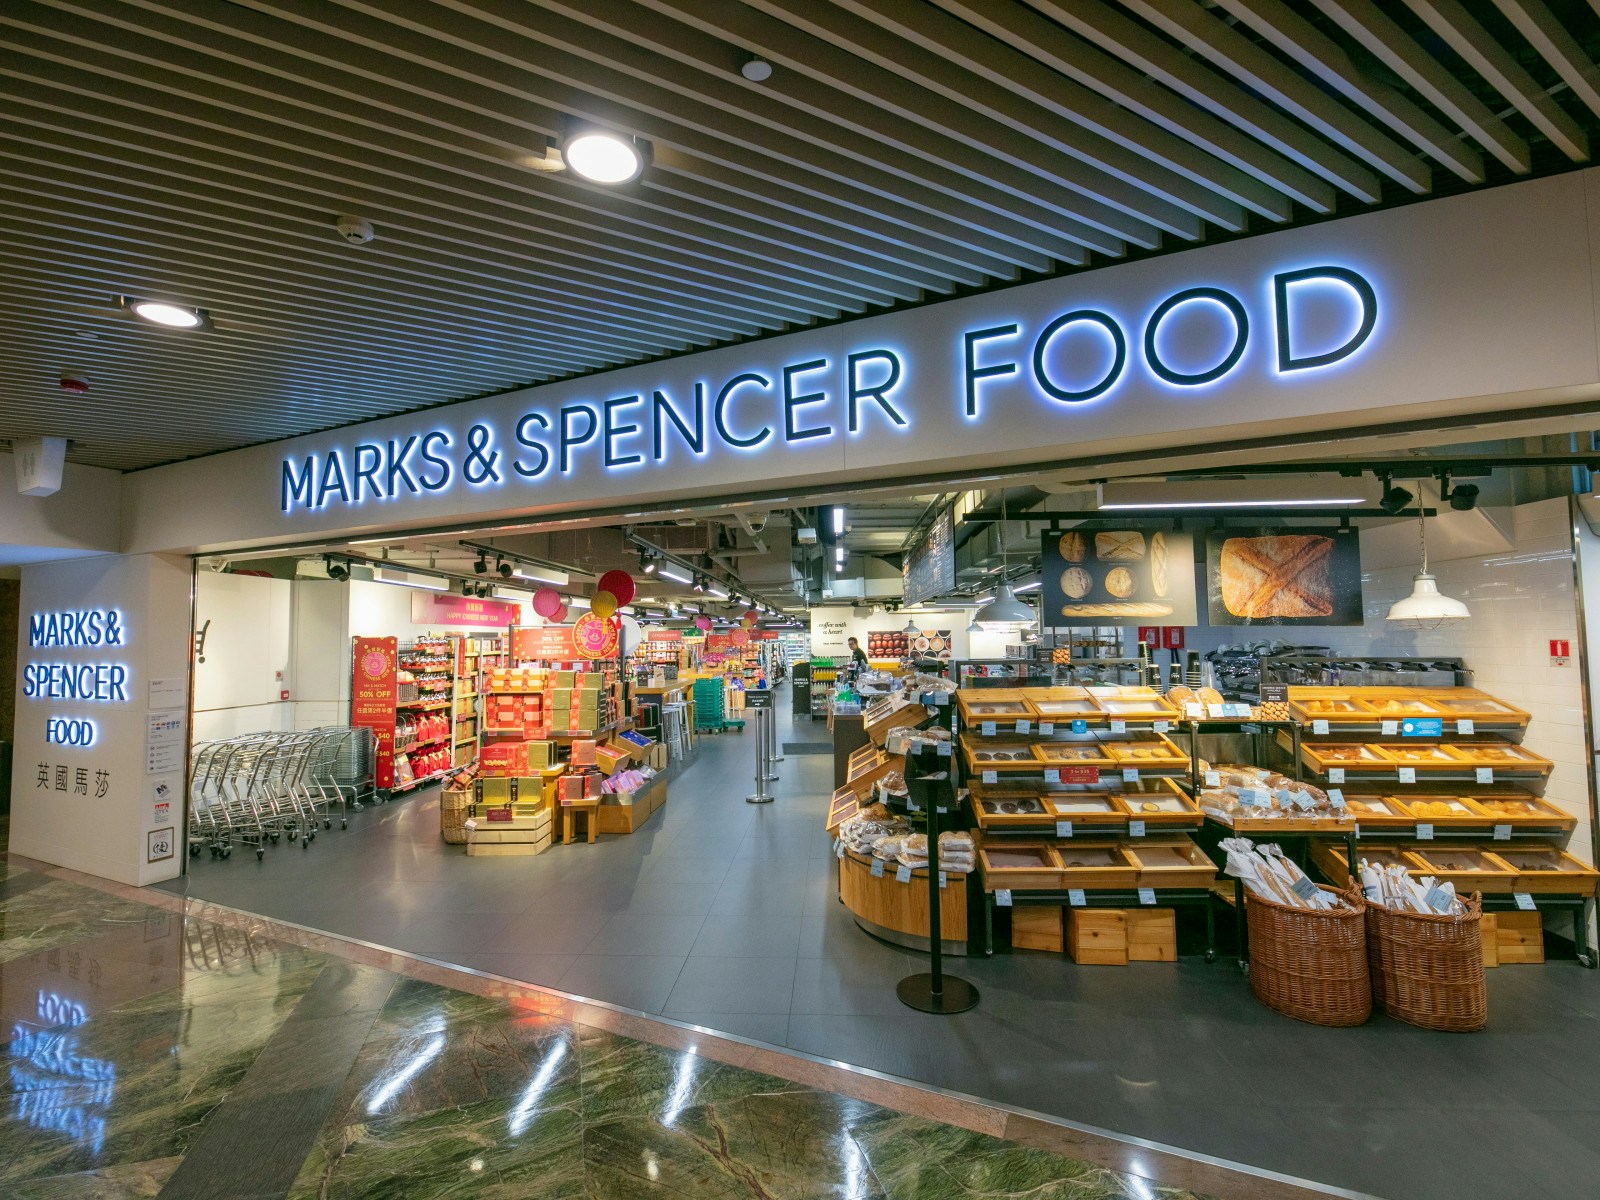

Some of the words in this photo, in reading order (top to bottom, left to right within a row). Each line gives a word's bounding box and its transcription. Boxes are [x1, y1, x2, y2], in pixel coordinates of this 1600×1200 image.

[281, 431, 450, 512] MARKS
[463, 424, 500, 484] &
[512, 349, 908, 478] SPENCER
[964, 265, 1378, 416] FOOD
[29, 610, 102, 647] MARKS
[105, 610, 121, 645] &
[23, 664, 126, 701] SPENCER
[359, 690, 374, 698] 50%
[375, 690, 391, 698] OFF
[46, 718, 94, 746] FOOD
[36, 761, 110, 799] 英國馬莎
